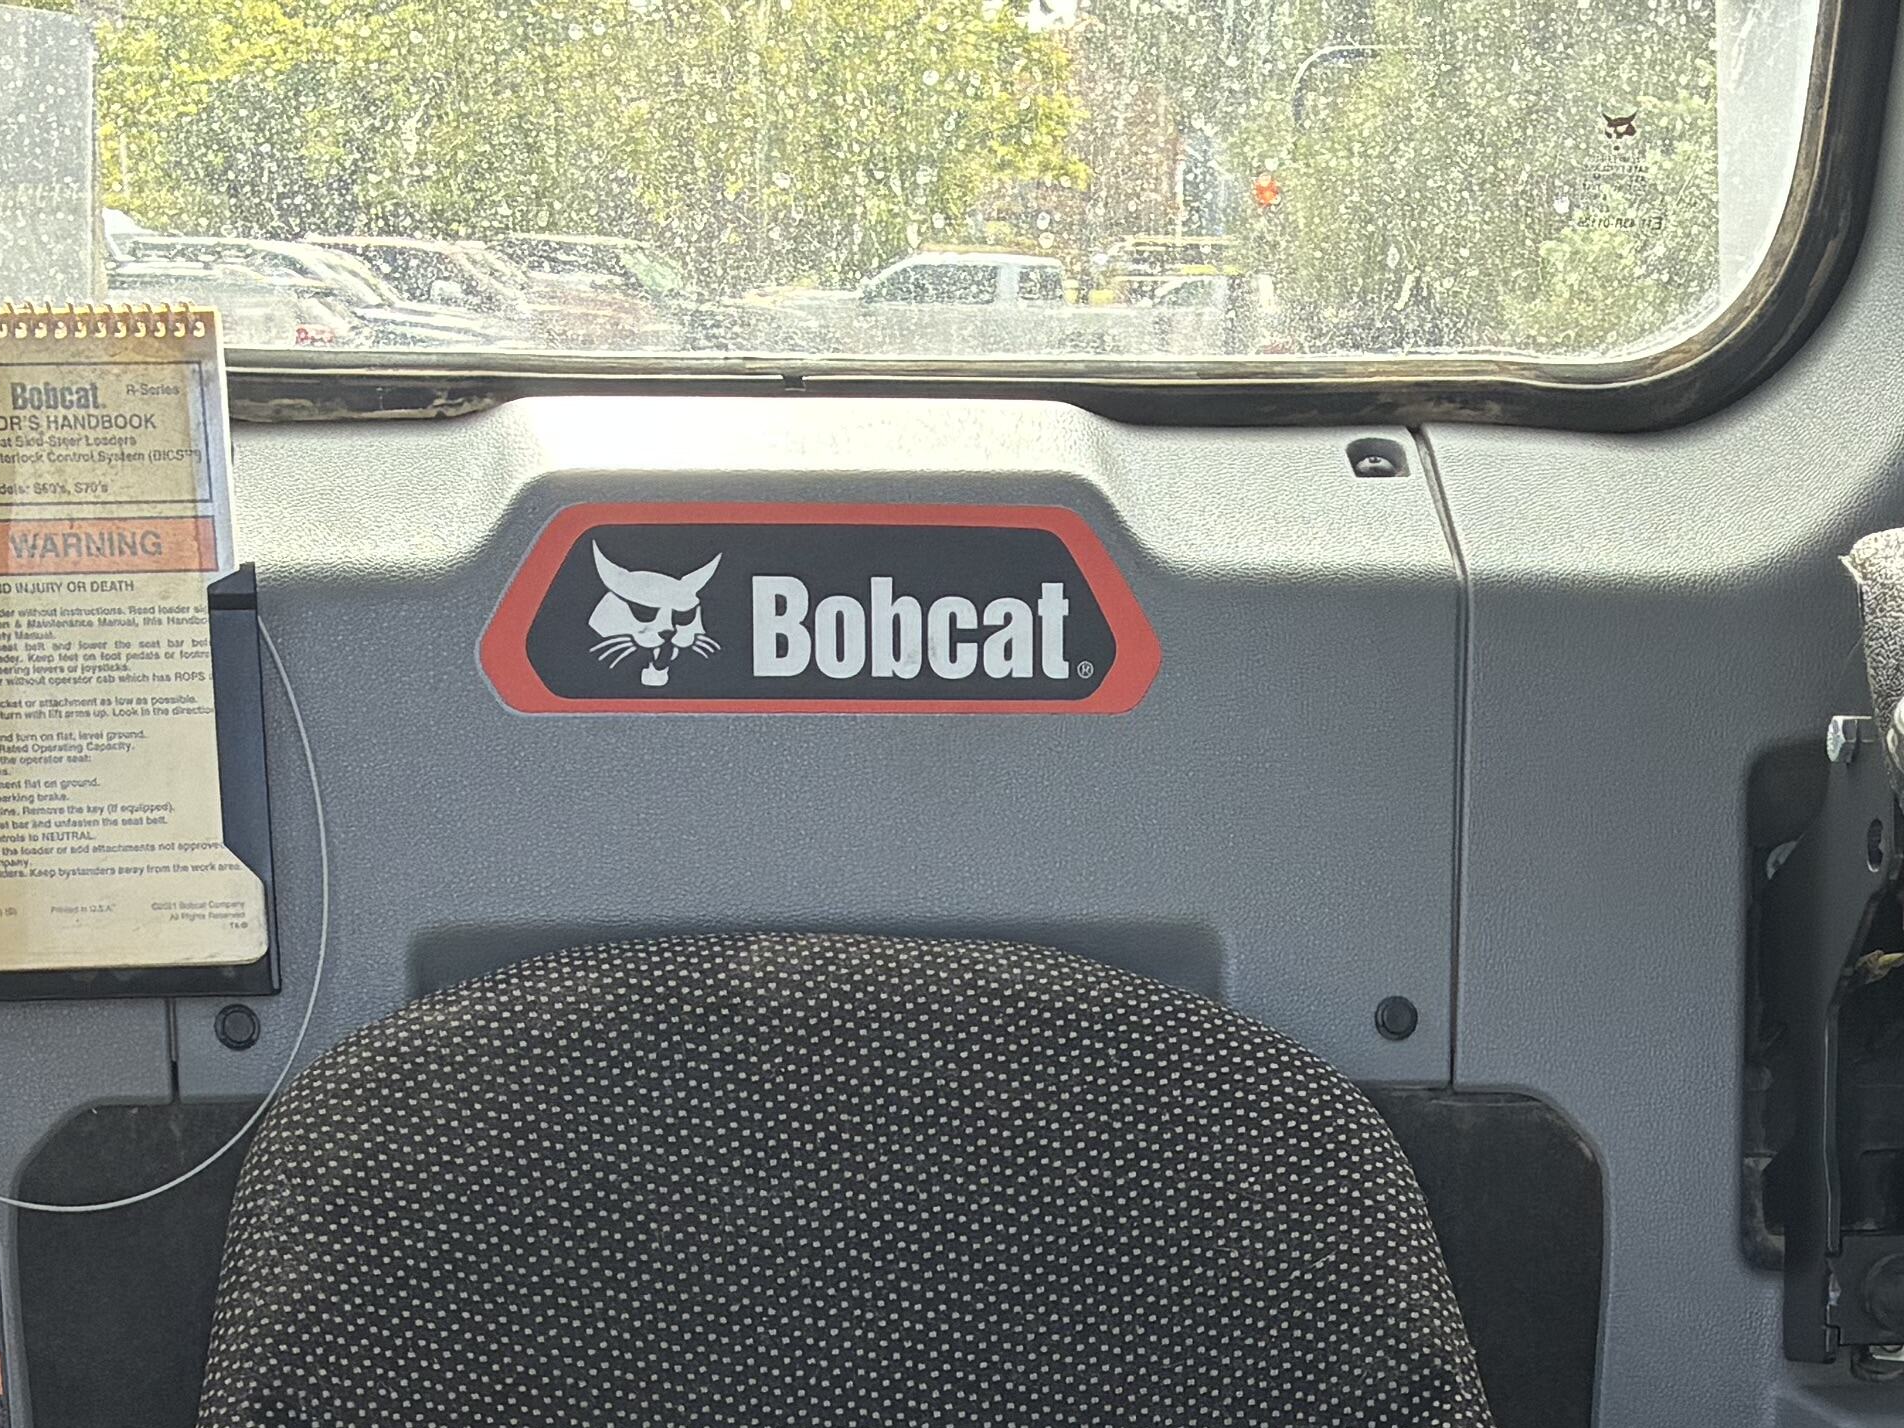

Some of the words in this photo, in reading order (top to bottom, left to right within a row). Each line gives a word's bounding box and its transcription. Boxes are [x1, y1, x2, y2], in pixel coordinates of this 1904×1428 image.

[9, 382, 102, 410] Bobcat
[46, 413, 156, 430] HANDBOOK
[9, 530, 164, 558] WARNING
[15, 582, 62, 594] INJURY
[66, 581, 86, 592] OR
[90, 580, 134, 592] DEATH
[751, 574, 1070, 679] Bobcat
